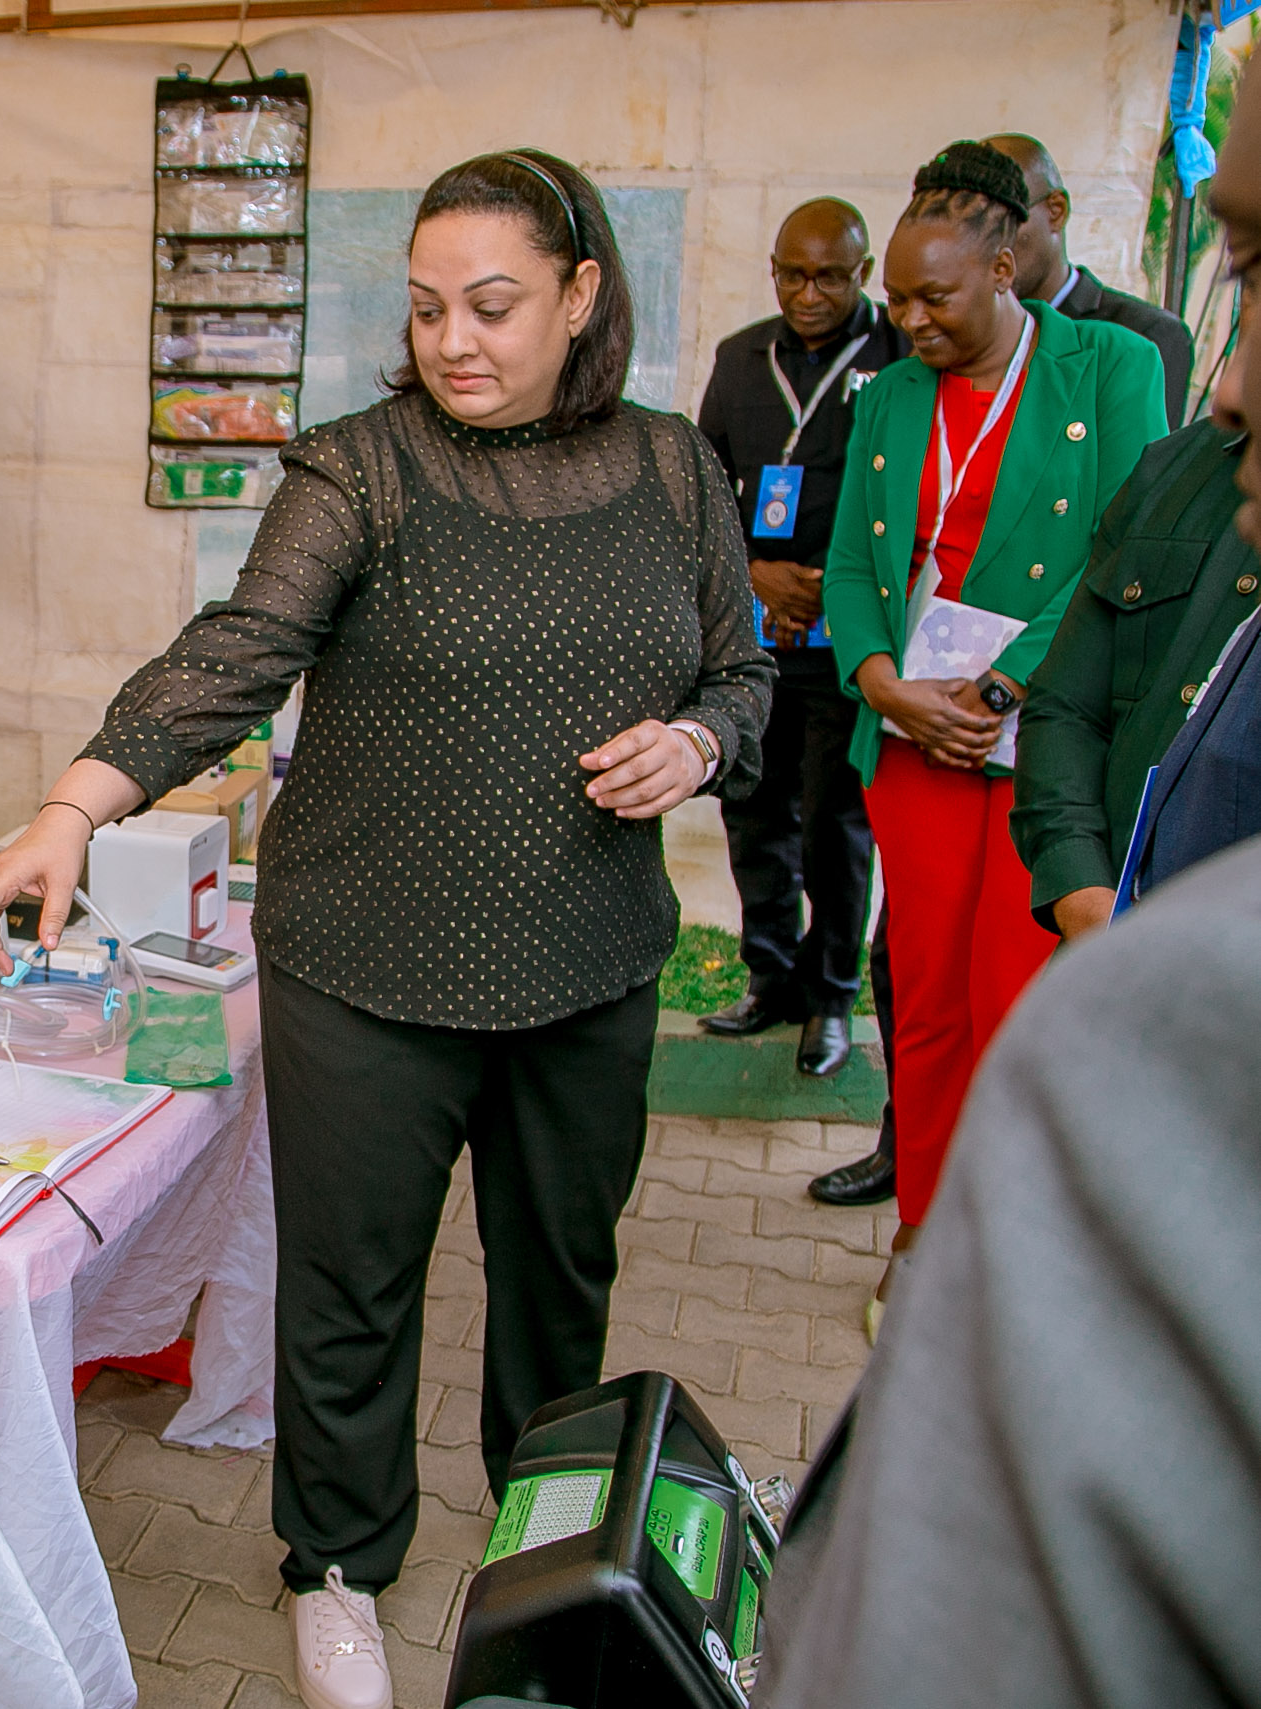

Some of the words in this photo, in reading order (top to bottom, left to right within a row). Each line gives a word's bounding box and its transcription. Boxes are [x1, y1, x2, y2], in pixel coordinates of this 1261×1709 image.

[699, 1517, 710, 1530] 20
[695, 1528, 707, 1551] CPAP
[691, 1551, 707, 1573] Baby
